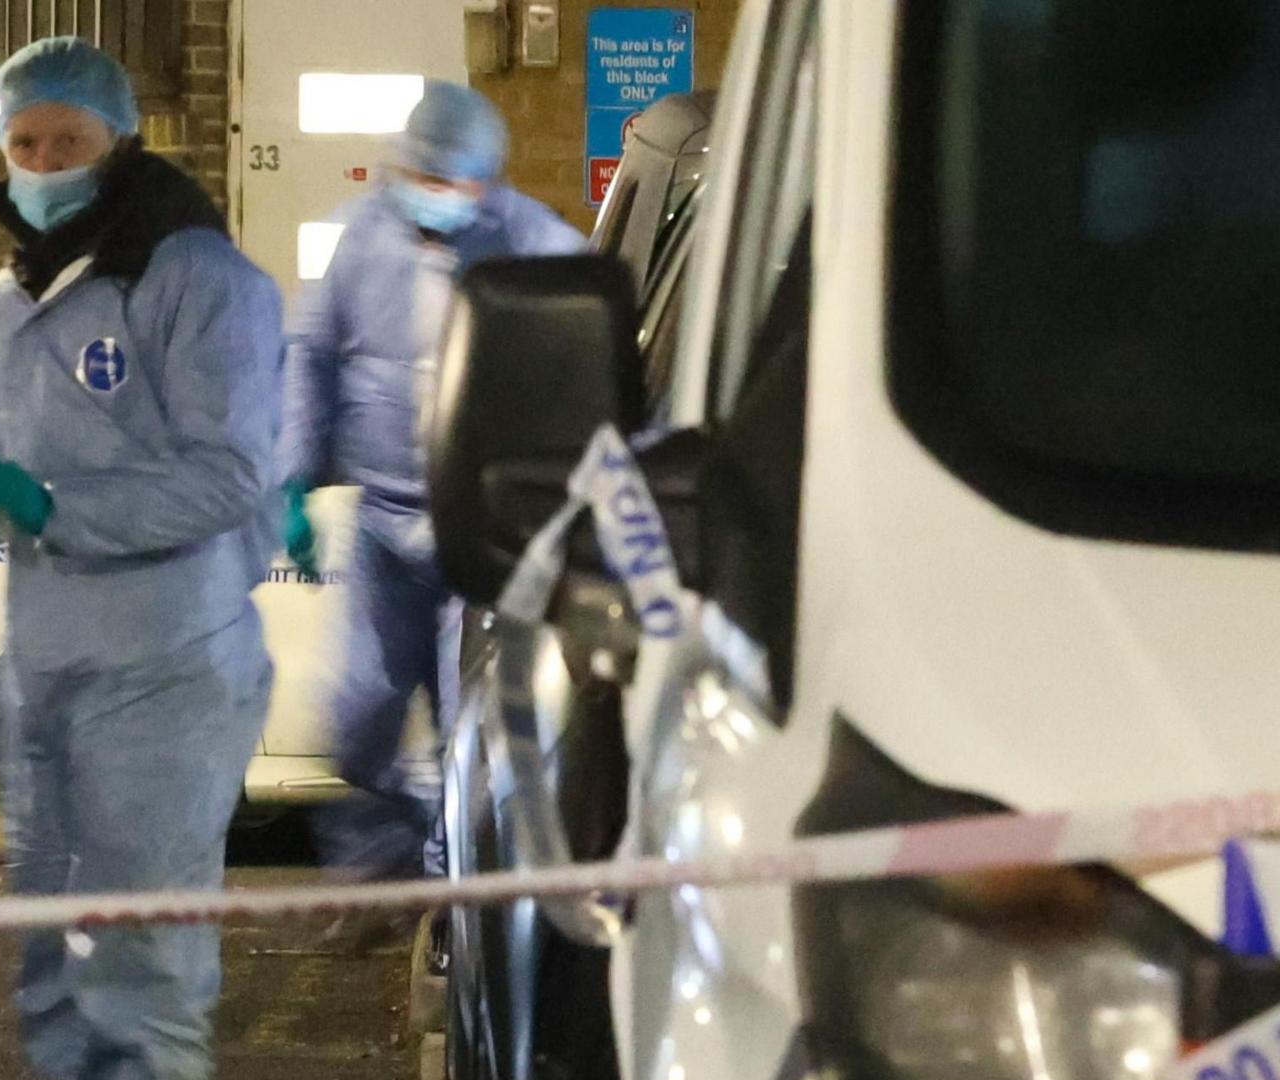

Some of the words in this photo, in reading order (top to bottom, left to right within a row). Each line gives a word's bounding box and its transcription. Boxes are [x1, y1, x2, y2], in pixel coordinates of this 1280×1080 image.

[593, 38, 617, 51] This
[621, 41, 649, 52] area
[652, 39, 663, 51] is
[667, 38, 685, 52] for
[600, 55, 659, 68] residents
[662, 55, 676, 68] of
[606, 70, 631, 83] this
[635, 70, 669, 83] block
[620, 86, 656, 100] ONLY
[249, 144, 280, 171] 33
